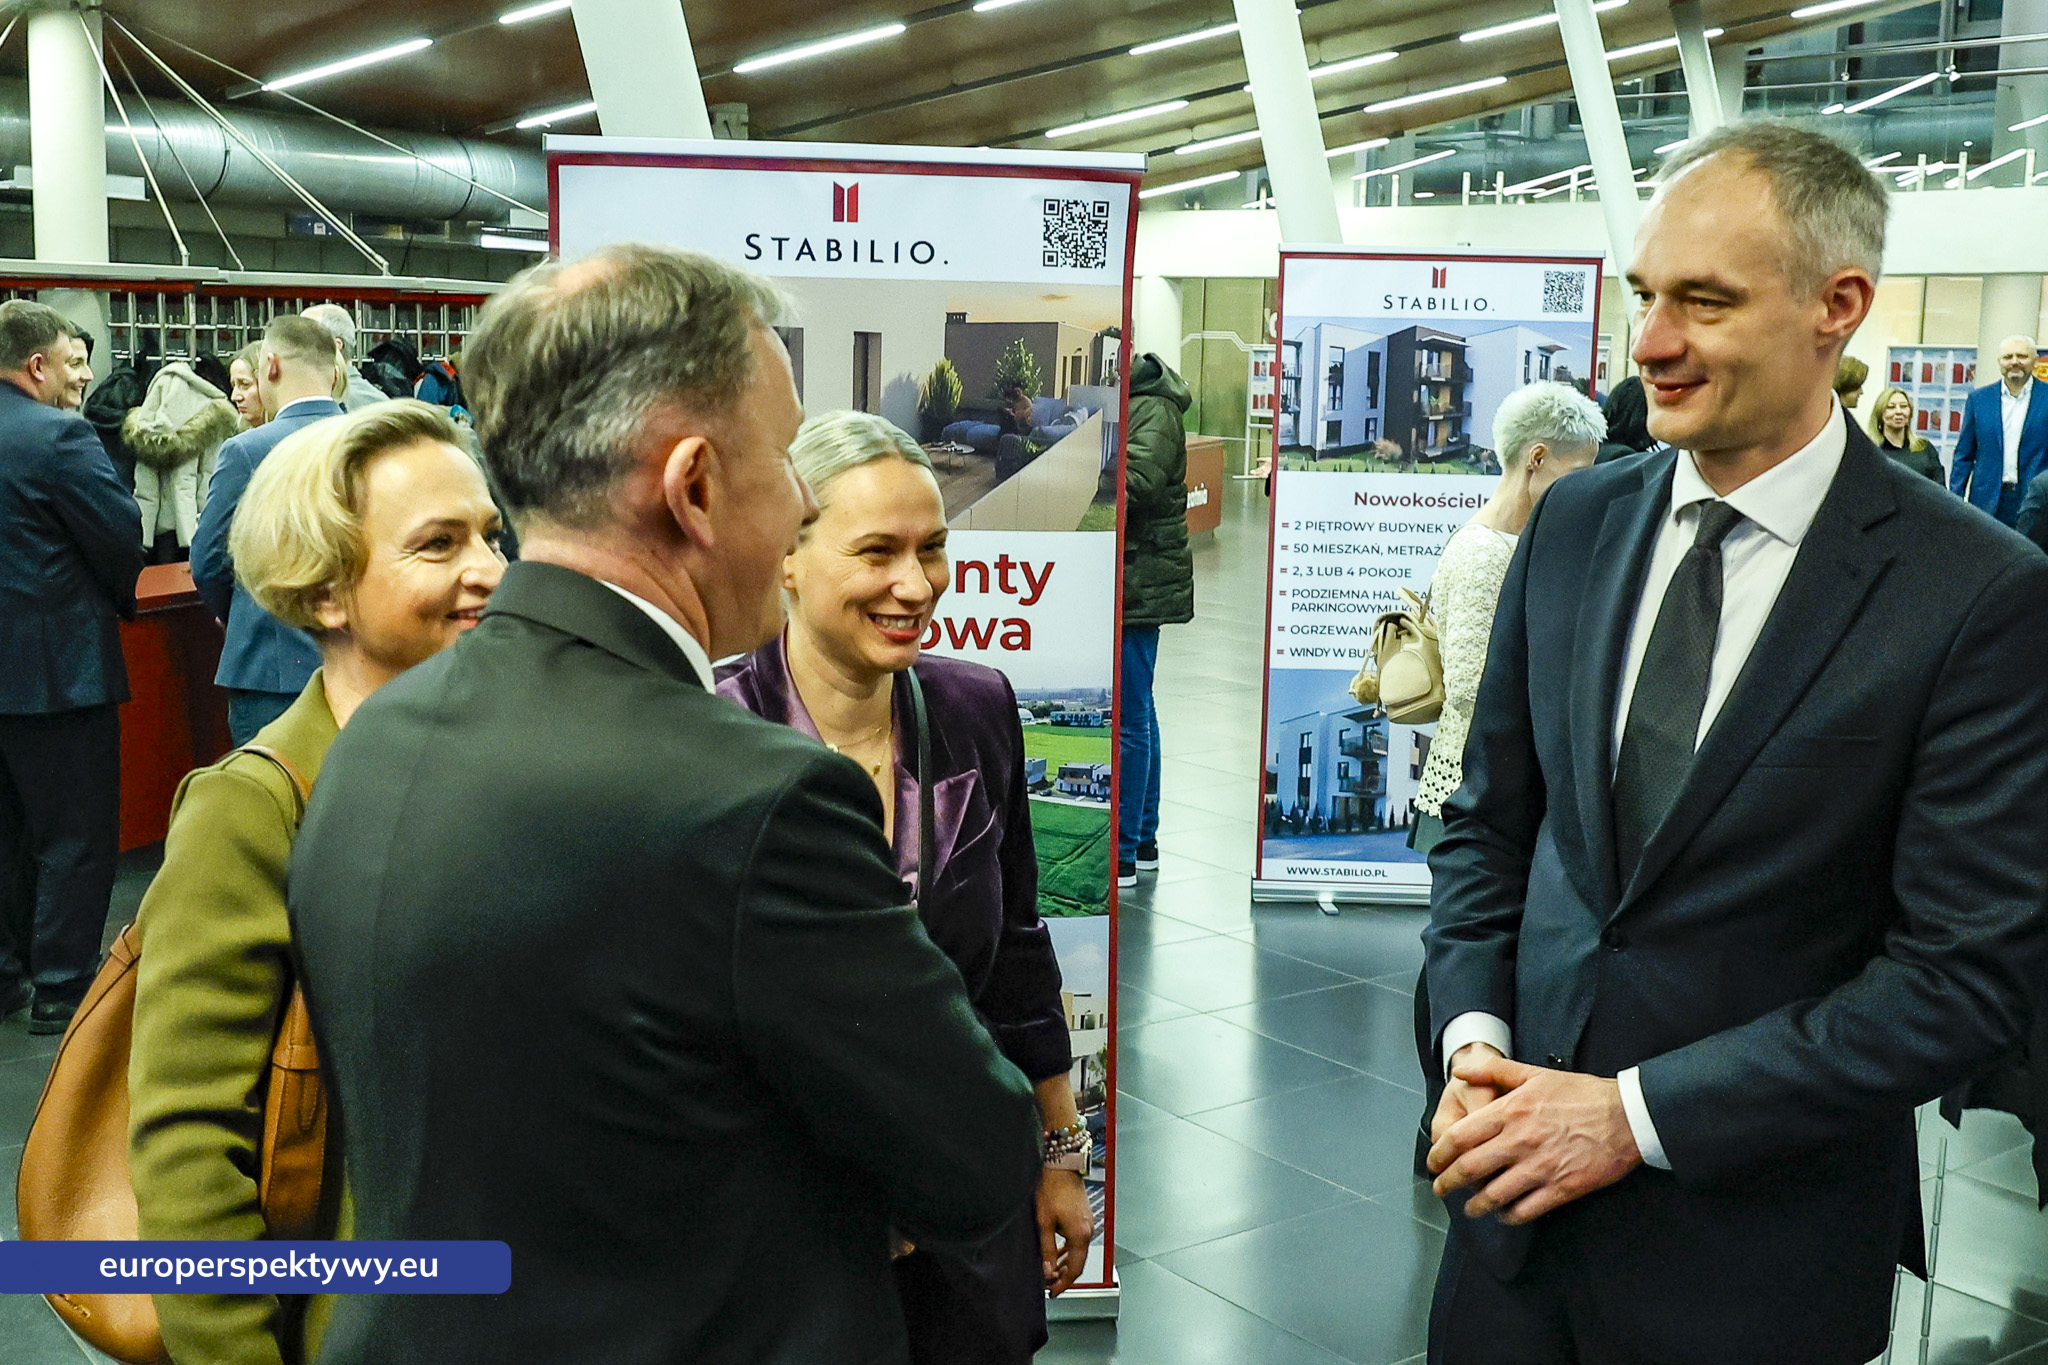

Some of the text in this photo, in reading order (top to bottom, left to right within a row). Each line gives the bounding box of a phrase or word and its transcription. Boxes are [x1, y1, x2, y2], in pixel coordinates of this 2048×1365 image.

[744, 233, 949, 265] STABILIO.
[1383, 294, 1496, 312] STABILIO.
[1294, 521, 1301, 531] 2
[1305, 521, 1374, 534] PIĘTROWY
[1379, 522, 1444, 533] BUDYNEK
[1293, 542, 1442, 557] 50 MIESZKAŃ, METRAŻ
[1292, 566, 1412, 578] 2, 3 LUB 4 POKOJE
[1291, 588, 1369, 600] PODZIEMNA
[1373, 590, 1401, 601] HAL
[1289, 647, 1369, 658] WINDY W BU
[1286, 866, 1388, 878] WWW.STABILIO.PL
